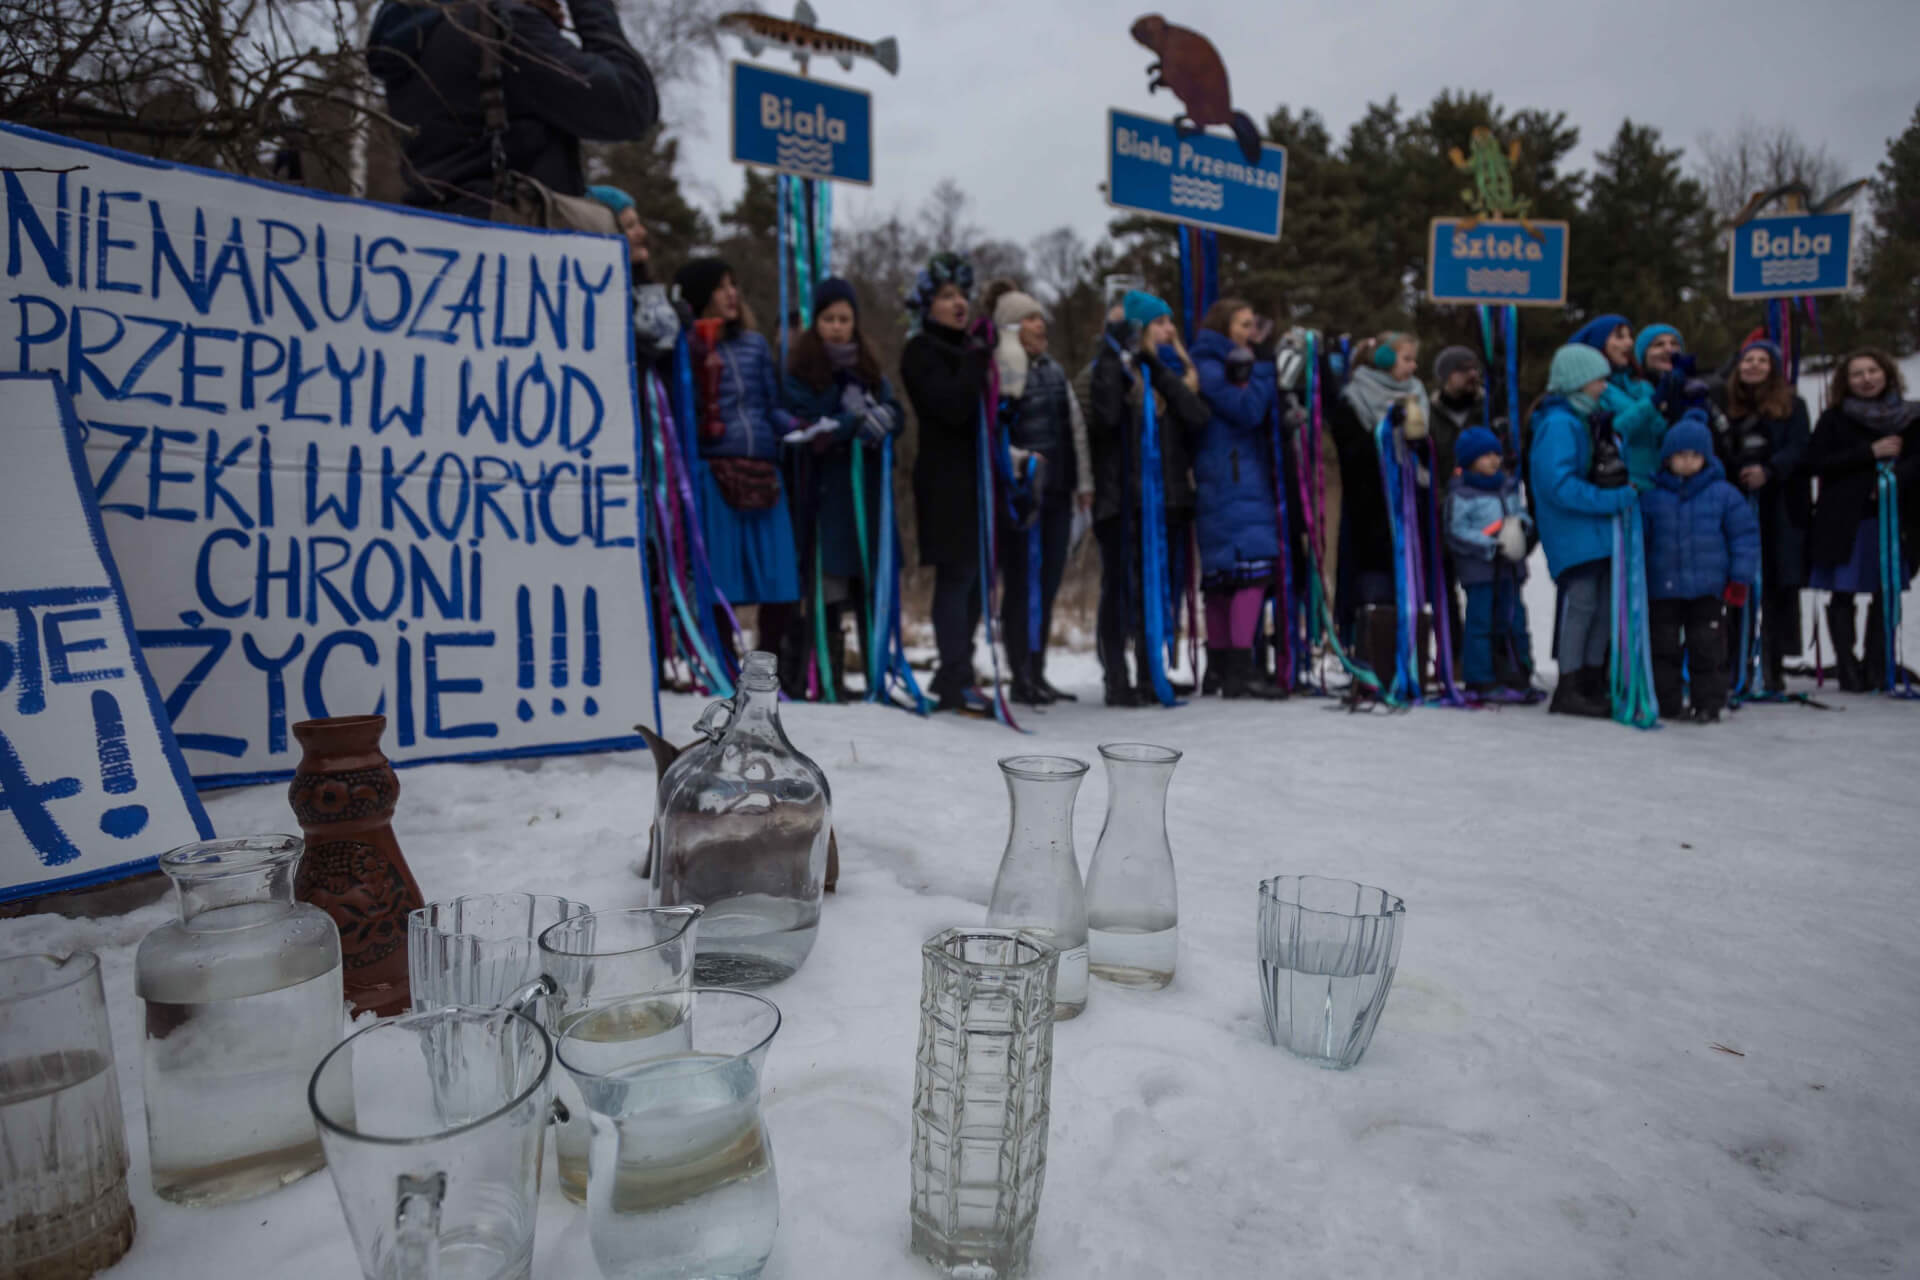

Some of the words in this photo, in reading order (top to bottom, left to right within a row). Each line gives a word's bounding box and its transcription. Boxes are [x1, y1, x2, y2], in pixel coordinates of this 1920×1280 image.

[3, 168, 613, 351] NIENARUSZALNY
[1751, 225, 1832, 259] Baba
[10, 294, 426, 437] PRZEPŁYW
[457, 352, 604, 451] WÓD
[79, 423, 275, 530] ZEKI
[304, 441, 362, 531] W
[380, 446, 636, 549] KORYCIE
[195, 528, 482, 627] CHRONI
[0, 586, 125, 715] TE
